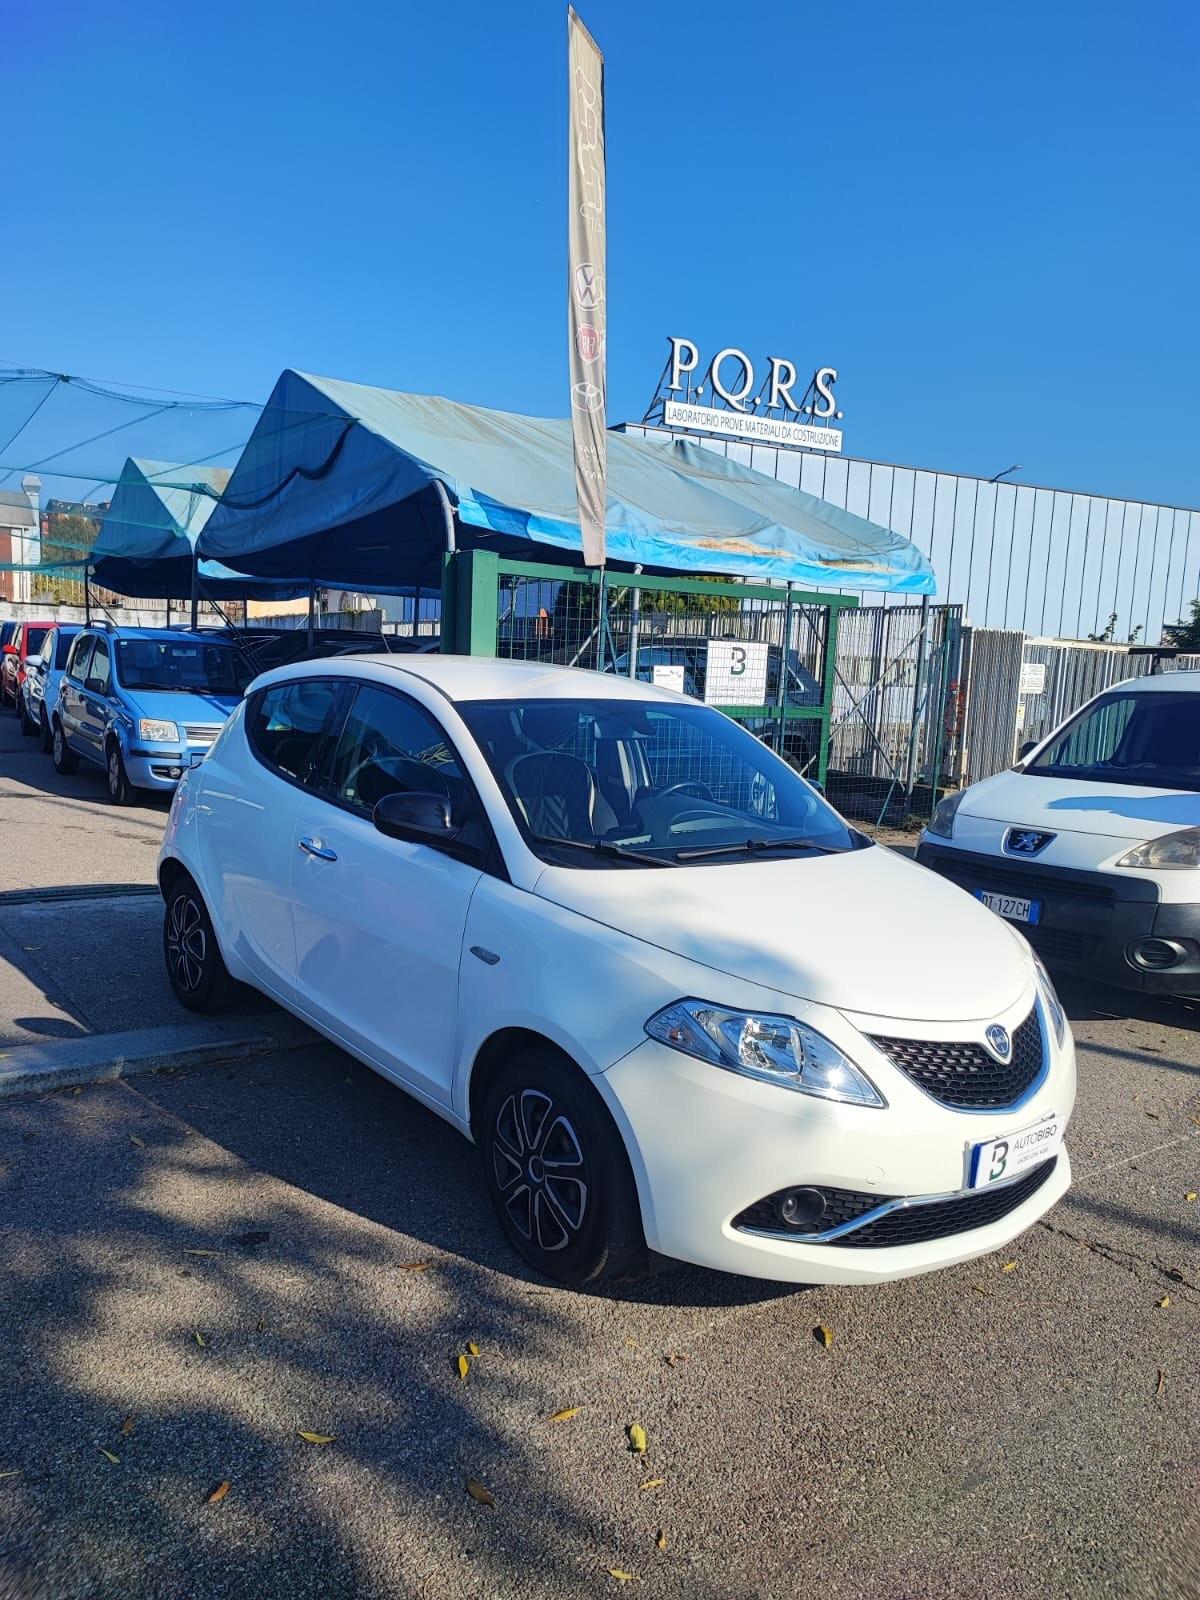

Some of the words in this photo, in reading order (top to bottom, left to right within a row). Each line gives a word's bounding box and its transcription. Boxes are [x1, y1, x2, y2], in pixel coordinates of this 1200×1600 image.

[666, 336, 843, 419] P.Q.R.S.
[668, 407, 719, 427] LABORATORIO
[720, 416, 743, 432] PROVE
[744, 420, 781, 438] MATERIALI
[781, 427, 792, 440] DA
[792, 429, 839, 447] COSTRUZIONE
[998, 899, 1030, 917] 127CH
[1012, 1124, 1057, 1152] AUTOBIBO
